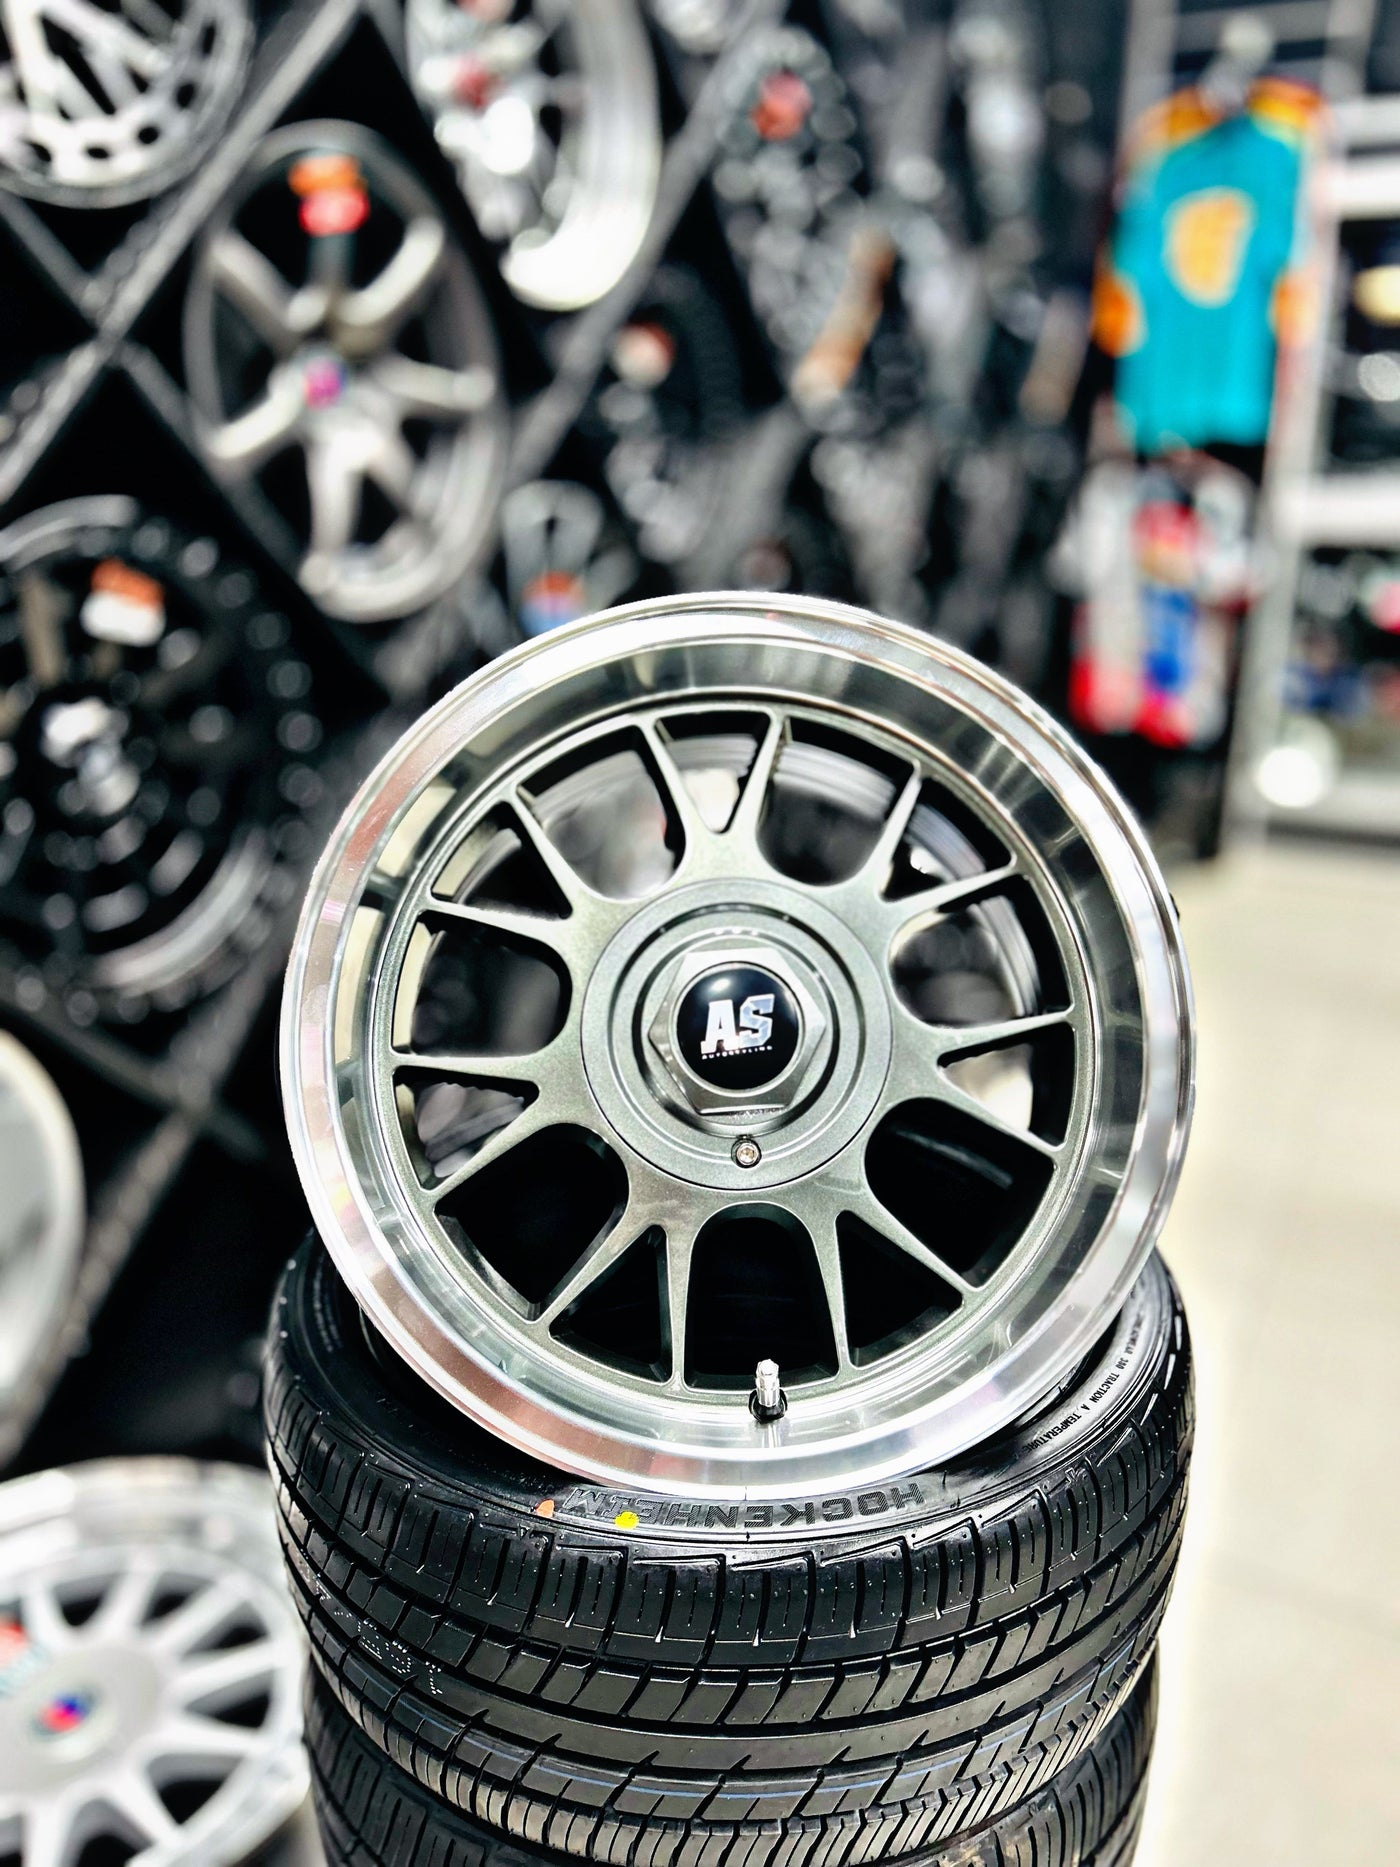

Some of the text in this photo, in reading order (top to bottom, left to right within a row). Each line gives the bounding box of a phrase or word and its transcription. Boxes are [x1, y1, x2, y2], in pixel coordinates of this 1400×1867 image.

[700, 993, 775, 1054] AS
[1080, 1403, 1090, 1411] A
[1089, 1372, 1120, 1404] TRACTION
[1024, 1412, 1082, 1453] TEMPERATURE
[562, 1482, 926, 1529] HOCKENHEIM
